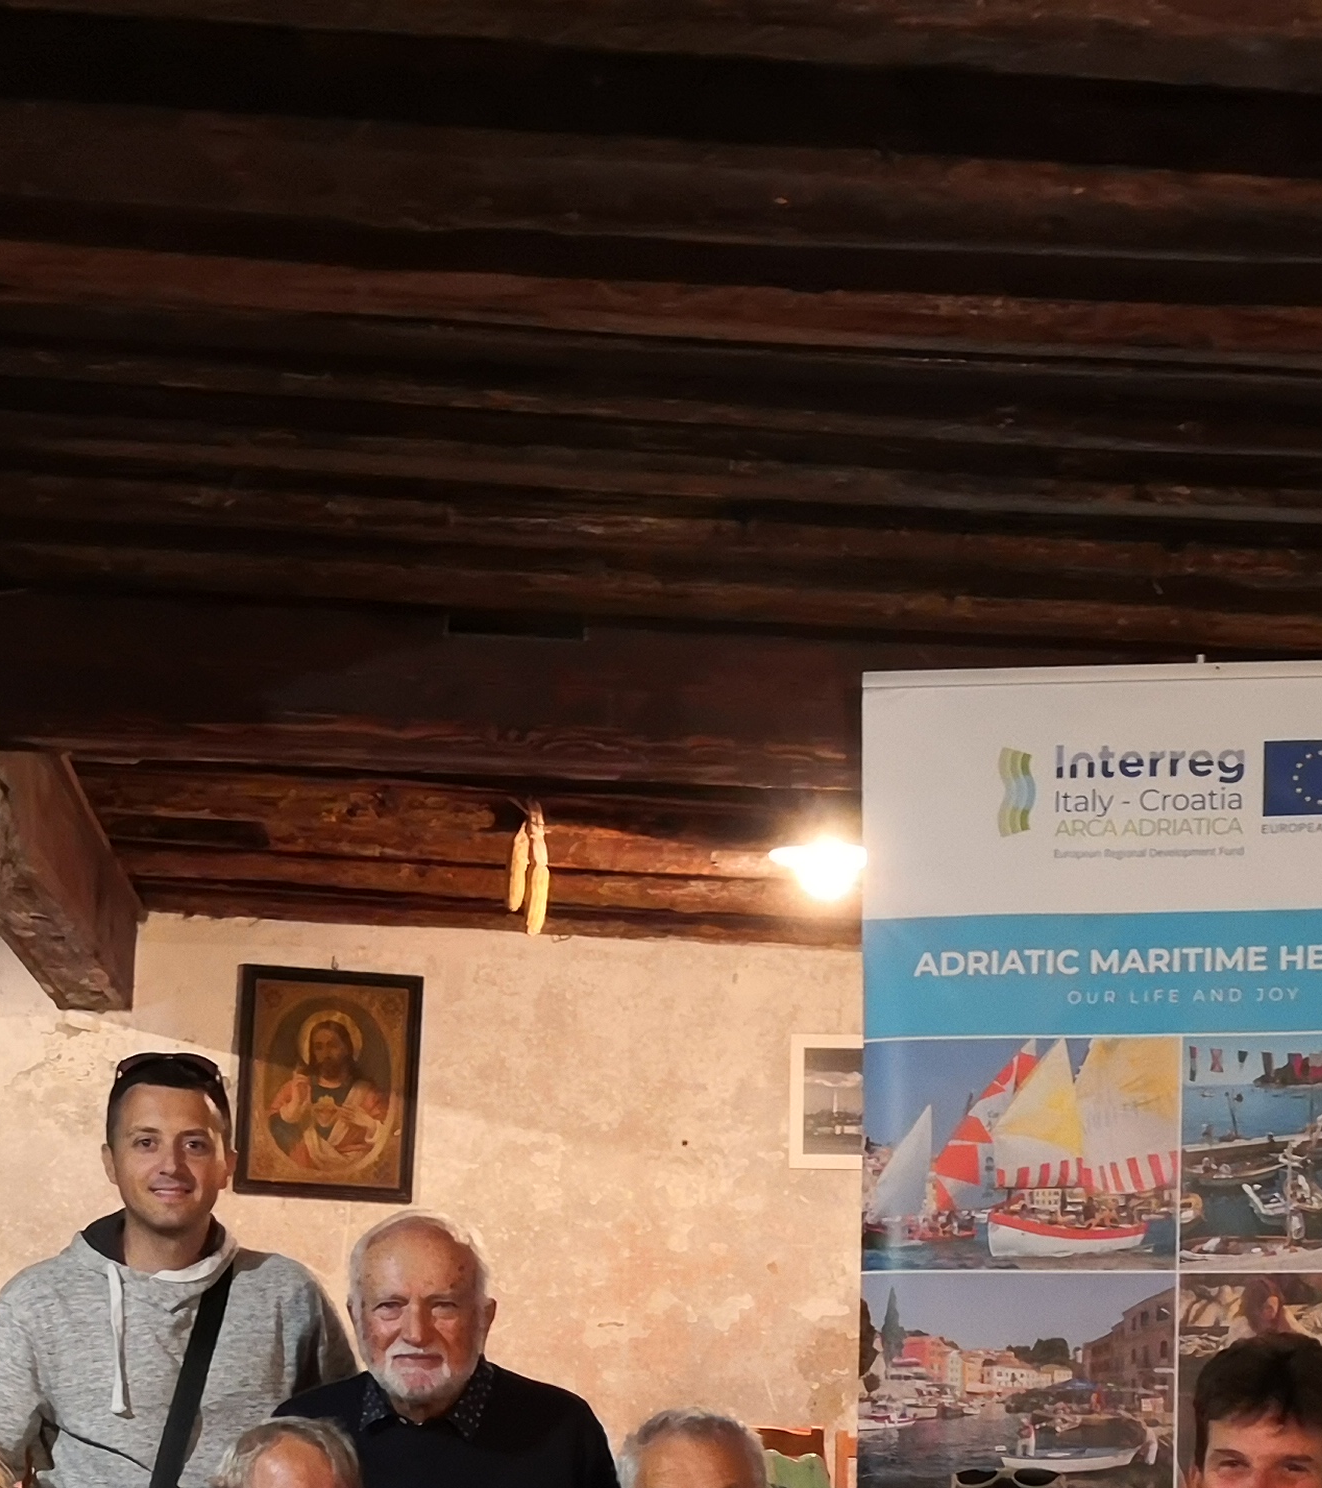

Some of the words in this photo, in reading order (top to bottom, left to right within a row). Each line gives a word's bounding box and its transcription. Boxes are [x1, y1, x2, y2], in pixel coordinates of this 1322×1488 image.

[1055, 745, 1246, 784] Interreg
[1055, 788, 1114, 818] Italy
[1139, 787, 1243, 812] Croatia
[1054, 819, 1118, 838] ARCA
[1121, 817, 1244, 837] ADRIATICA
[913, 949, 1080, 978] ADRIATIC
[1090, 945, 1269, 975] MARITIME
[1067, 989, 1117, 1005] OUR
[1129, 988, 1180, 1005] LIFE
[1192, 987, 1244, 1003] AND
[1256, 986, 1300, 1003] JOY
